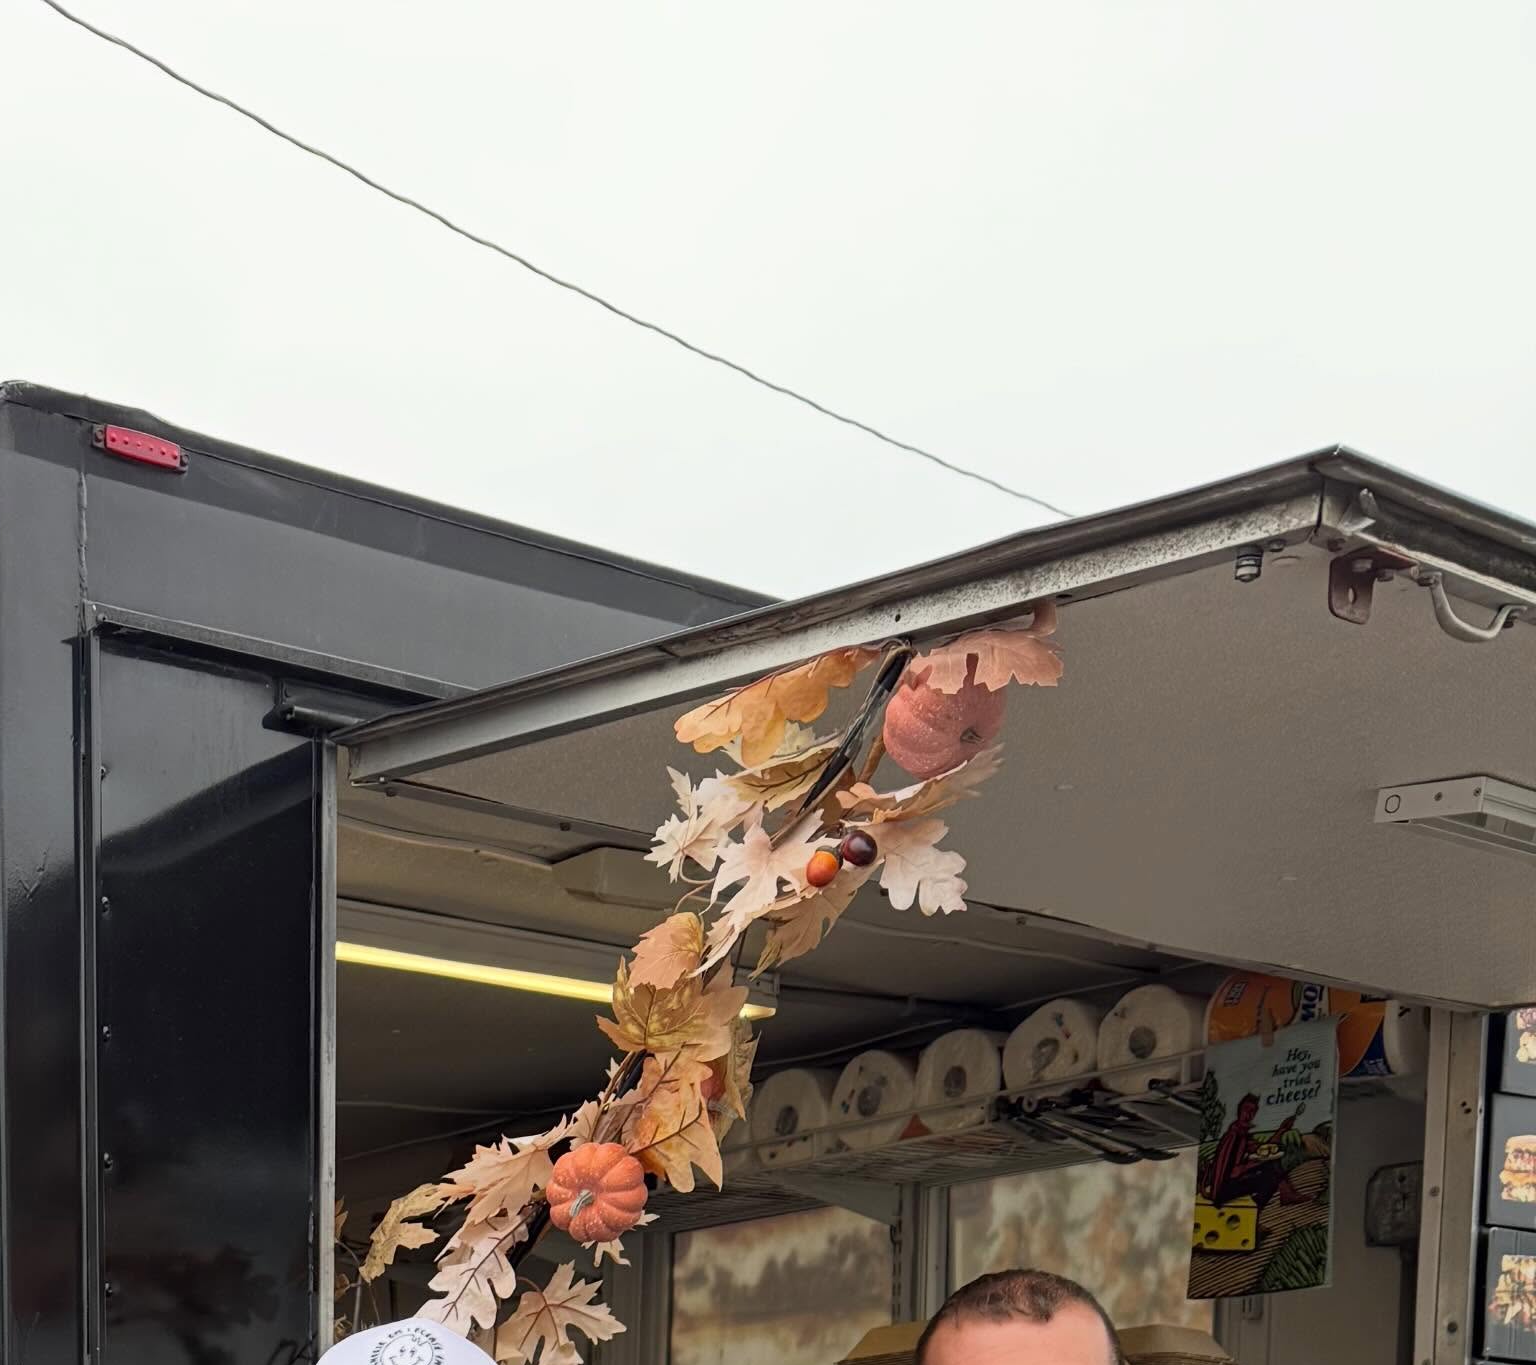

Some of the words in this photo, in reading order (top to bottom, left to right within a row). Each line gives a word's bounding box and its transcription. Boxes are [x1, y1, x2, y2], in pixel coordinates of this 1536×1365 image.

[1272, 1064, 1296, 1077] have
[1299, 1060, 1320, 1074] you
[1284, 1073, 1311, 1088] tried
[1266, 1080, 1321, 1105] cheese?
